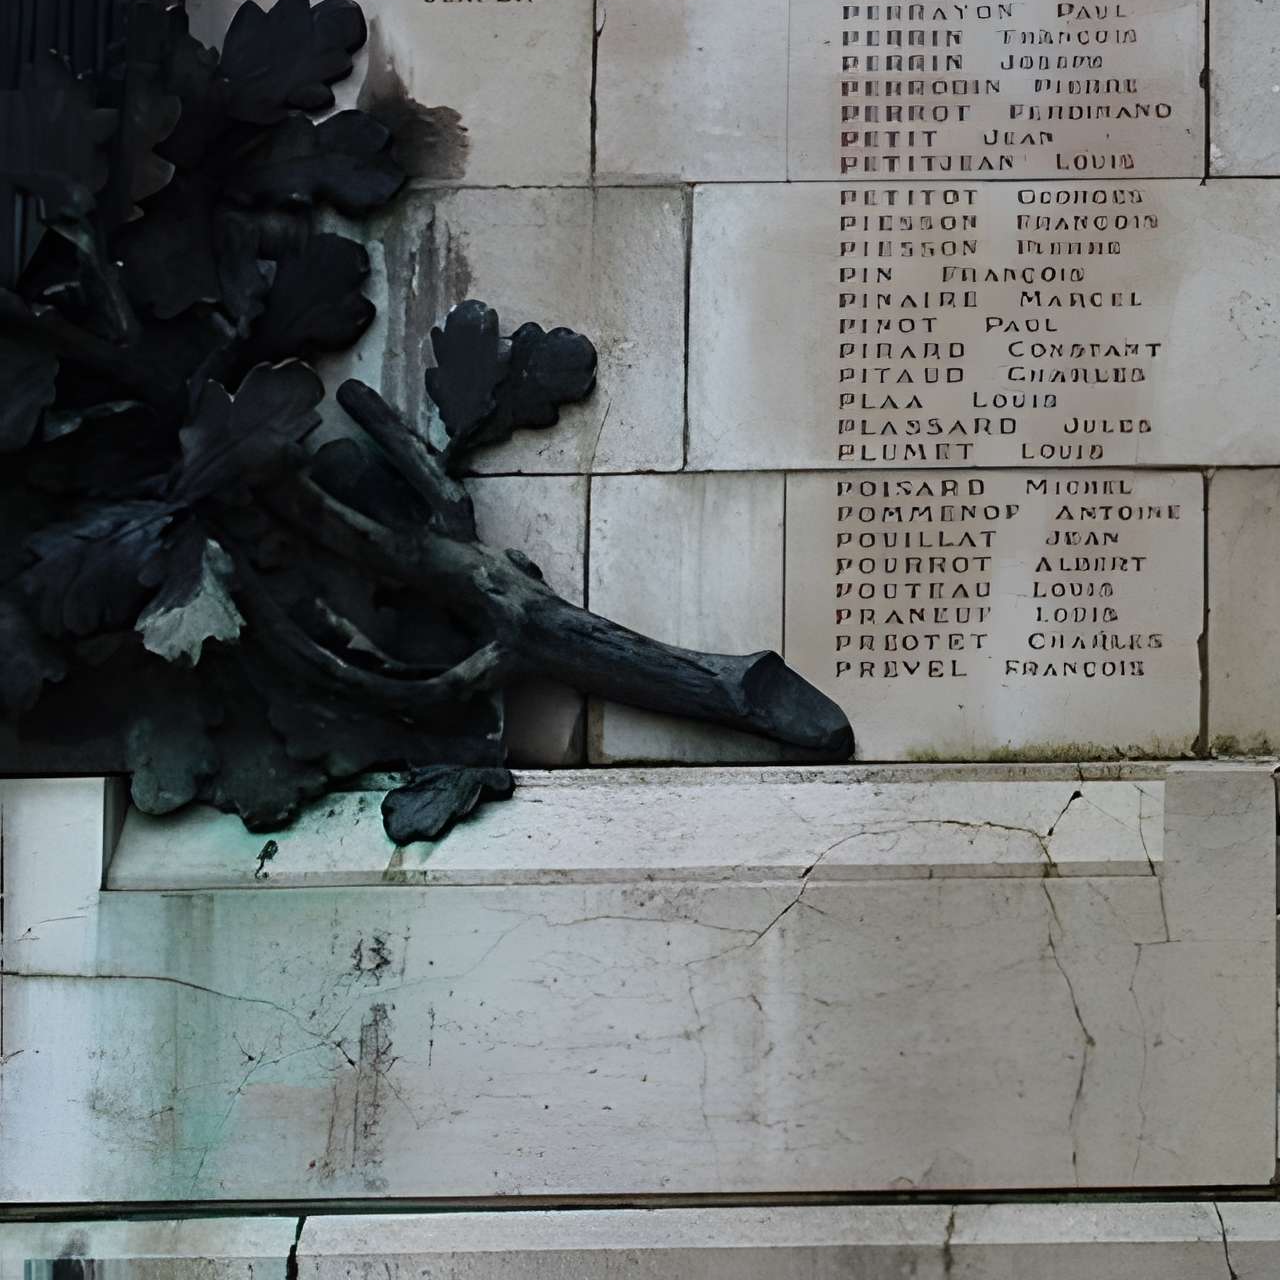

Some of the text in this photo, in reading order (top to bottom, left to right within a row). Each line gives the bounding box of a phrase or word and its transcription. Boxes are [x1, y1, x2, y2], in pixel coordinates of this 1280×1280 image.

[1056, 2, 1127, 21] PAUL
[839, 266, 893, 284] PIN
[985, 316, 1059, 333] PAUL
